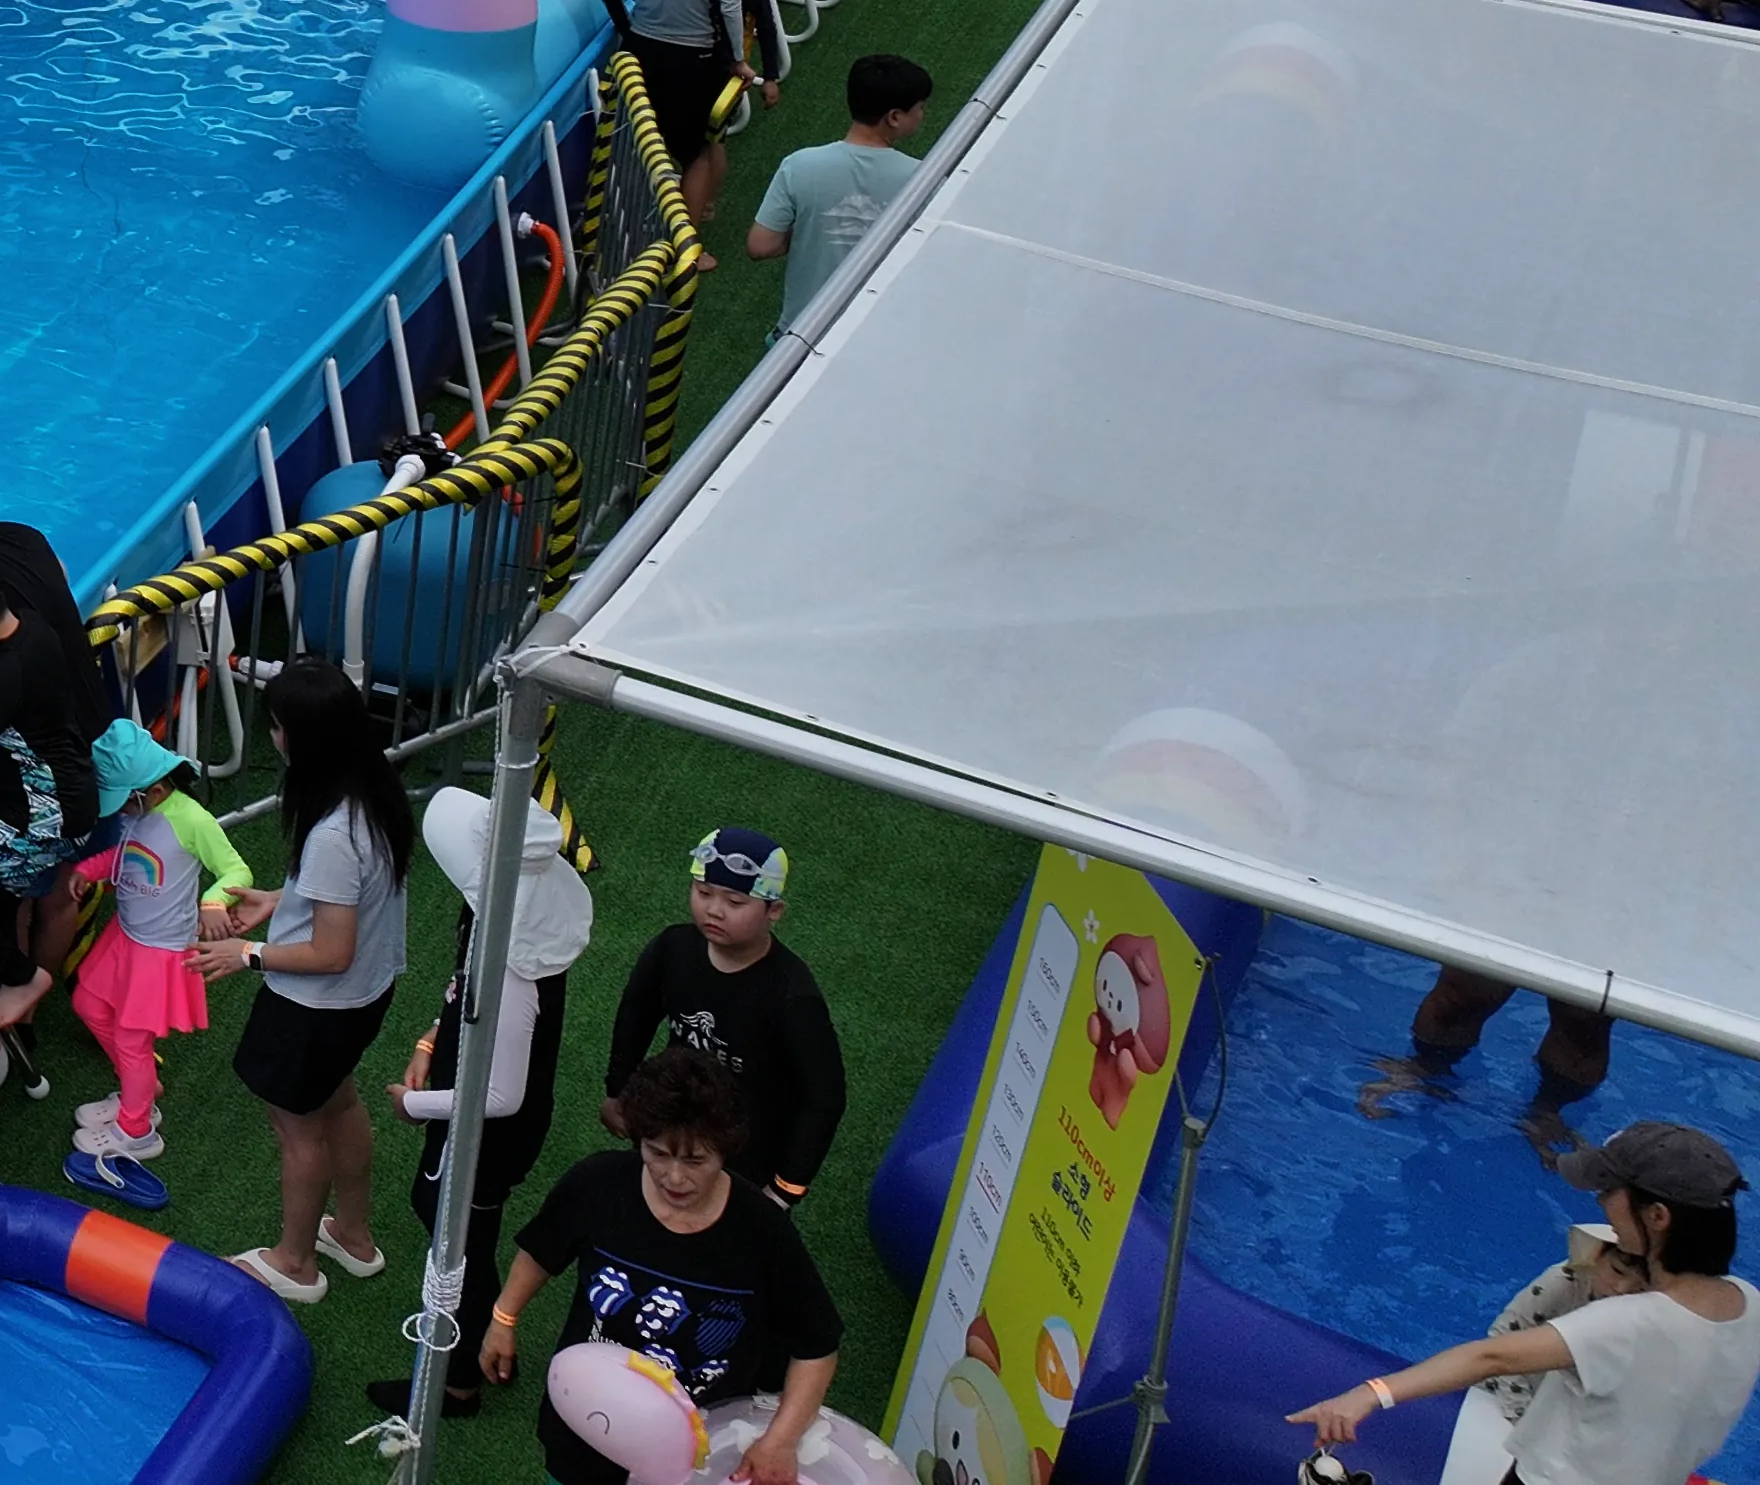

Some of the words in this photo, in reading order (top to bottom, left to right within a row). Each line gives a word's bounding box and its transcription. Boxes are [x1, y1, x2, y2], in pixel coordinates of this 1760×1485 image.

[141, 884, 161, 898] BIG
[979, 1161, 1003, 1208] 110cm
[1051, 1170, 1094, 1242] 슬라이드
